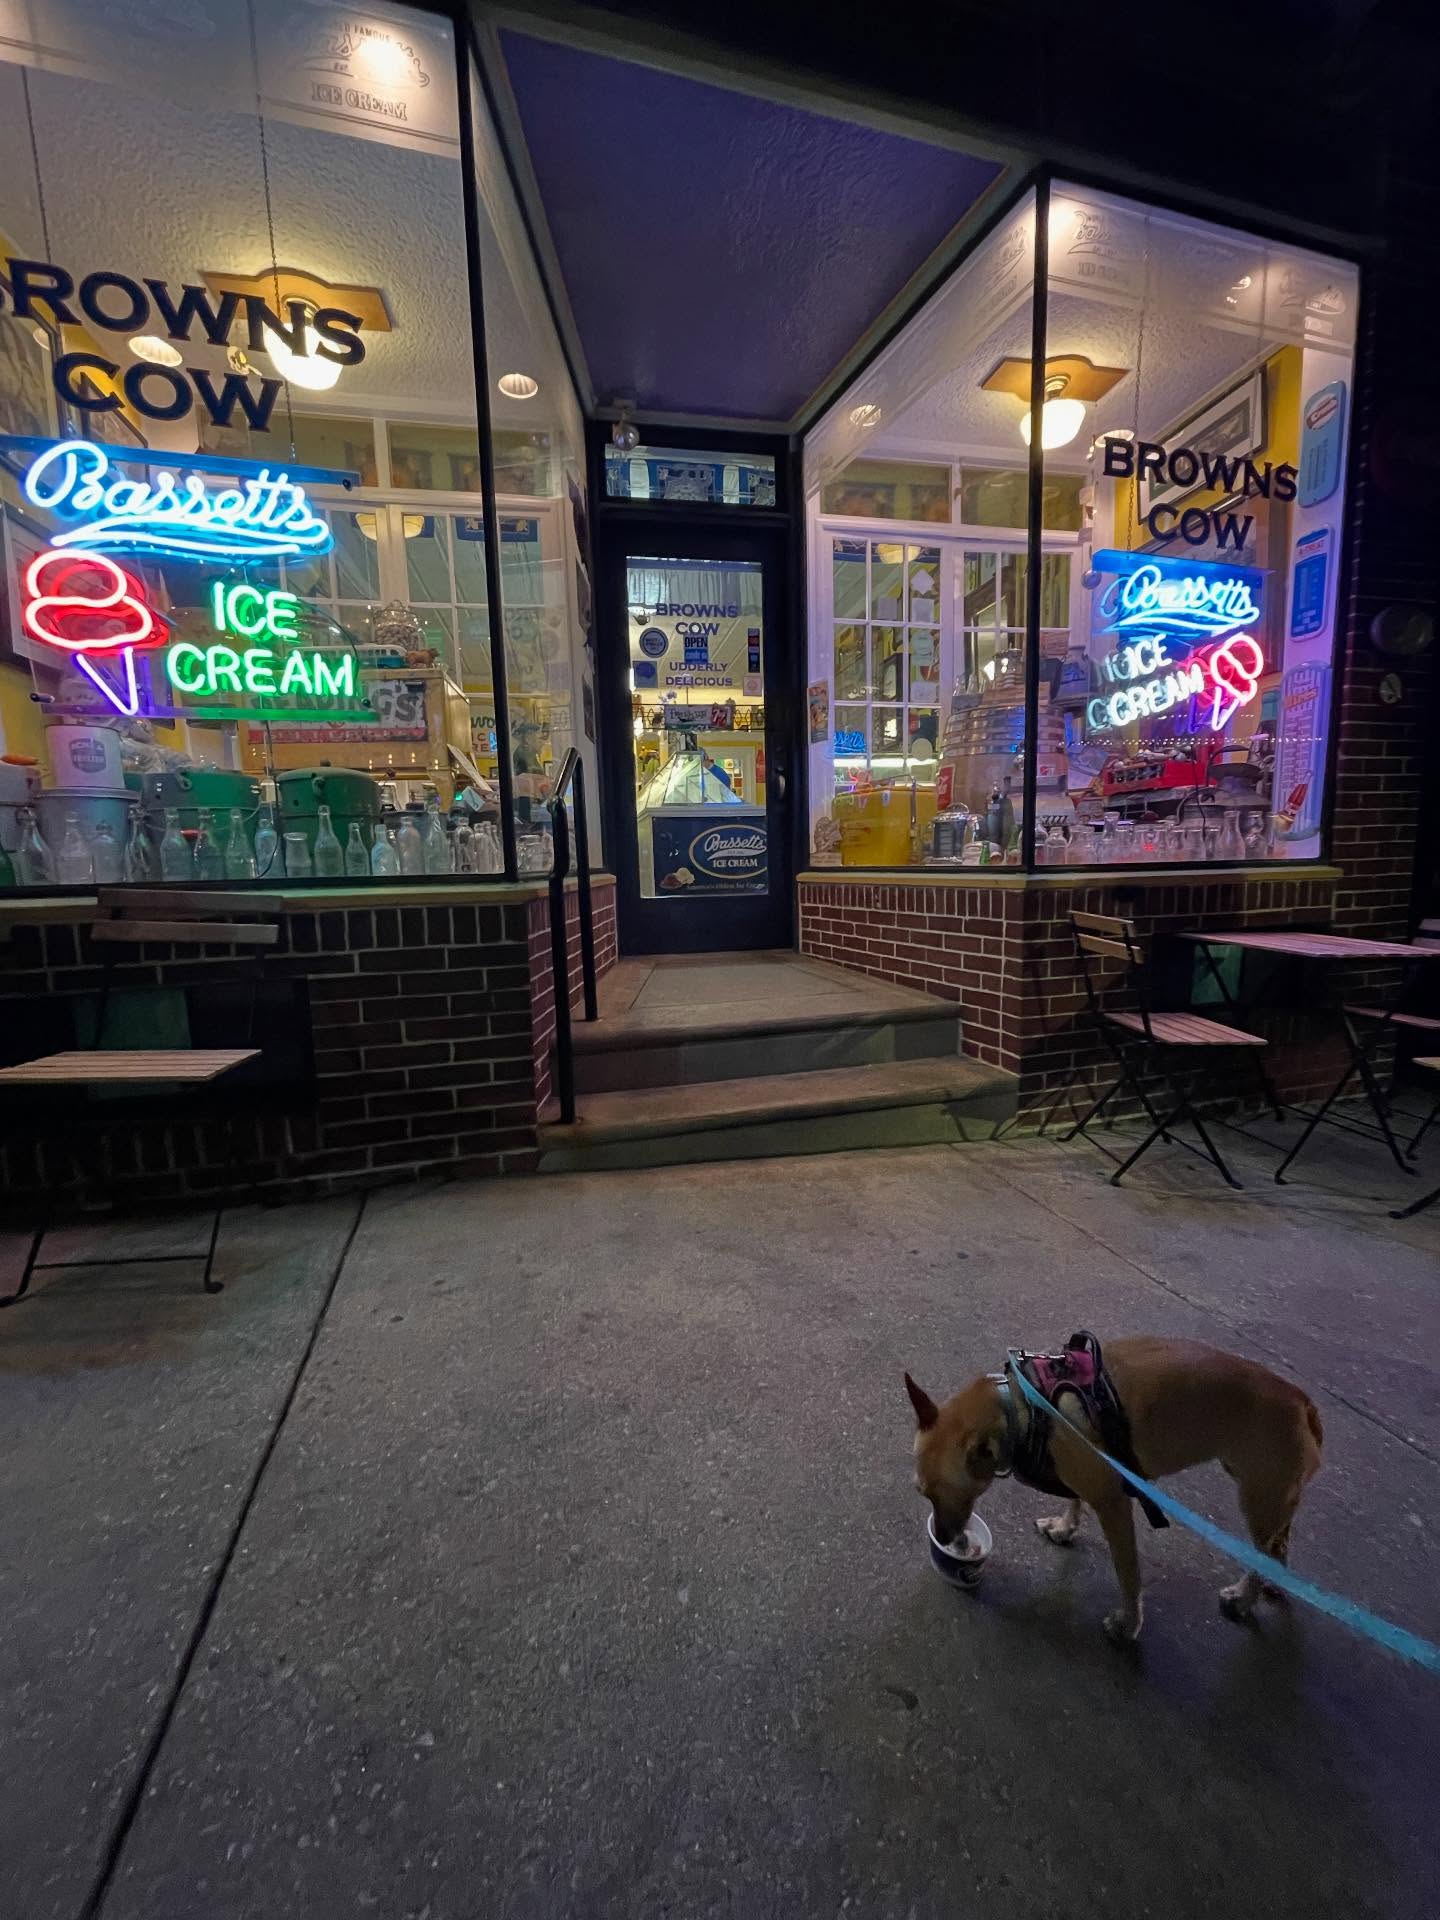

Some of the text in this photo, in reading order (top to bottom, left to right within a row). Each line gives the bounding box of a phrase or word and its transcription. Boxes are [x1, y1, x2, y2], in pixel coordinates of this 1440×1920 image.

[311, 82, 408, 121] ICE CREAM
[0, 257, 366, 366] ROWNS
[53, 353, 283, 432] COW
[25, 440, 329, 531] Bassetts
[1103, 437, 1298, 502] BROWNS
[1148, 504, 1254, 552] COW
[212, 581, 298, 637] ICE
[655, 603, 739, 618] BROWNS
[675, 622, 720, 635] COW
[684, 637, 708, 648] OPEN
[167, 643, 354, 696] CREAM
[665, 677, 733, 687] DELICIOUS
[669, 662, 728, 672] UDDERLY
[704, 833, 767, 853] Bassetts
[712, 859, 758, 868] ICE CREAM
